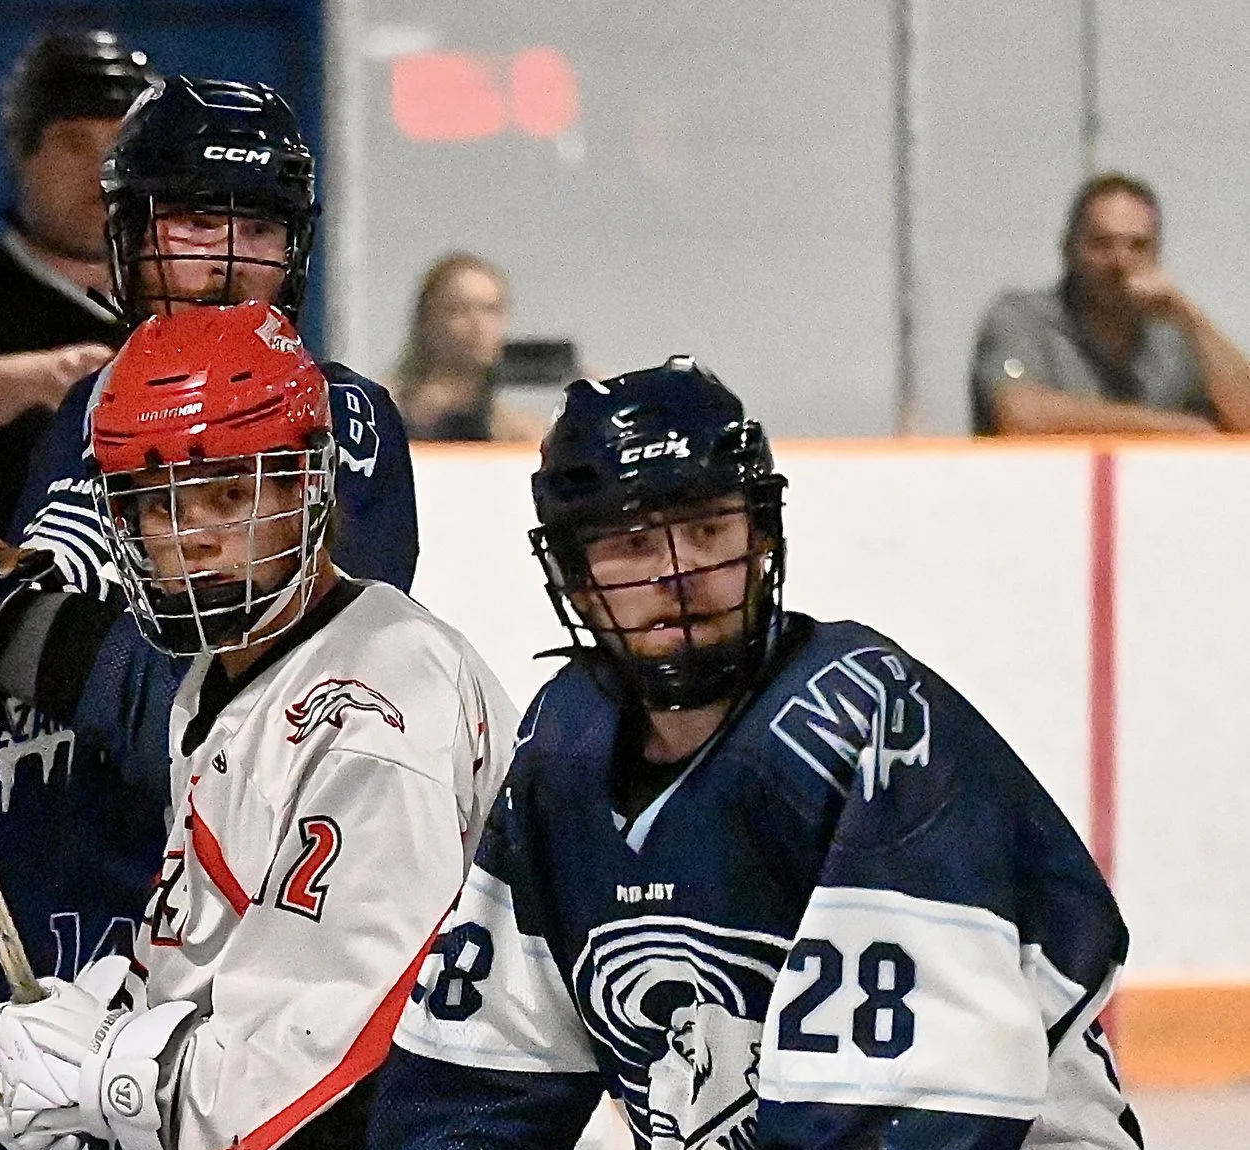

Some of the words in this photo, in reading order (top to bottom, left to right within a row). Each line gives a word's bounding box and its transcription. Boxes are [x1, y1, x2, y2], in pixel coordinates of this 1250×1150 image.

[203, 146, 271, 165] CCM
[619, 437, 691, 464] CCM
[777, 937, 916, 1060] 28
